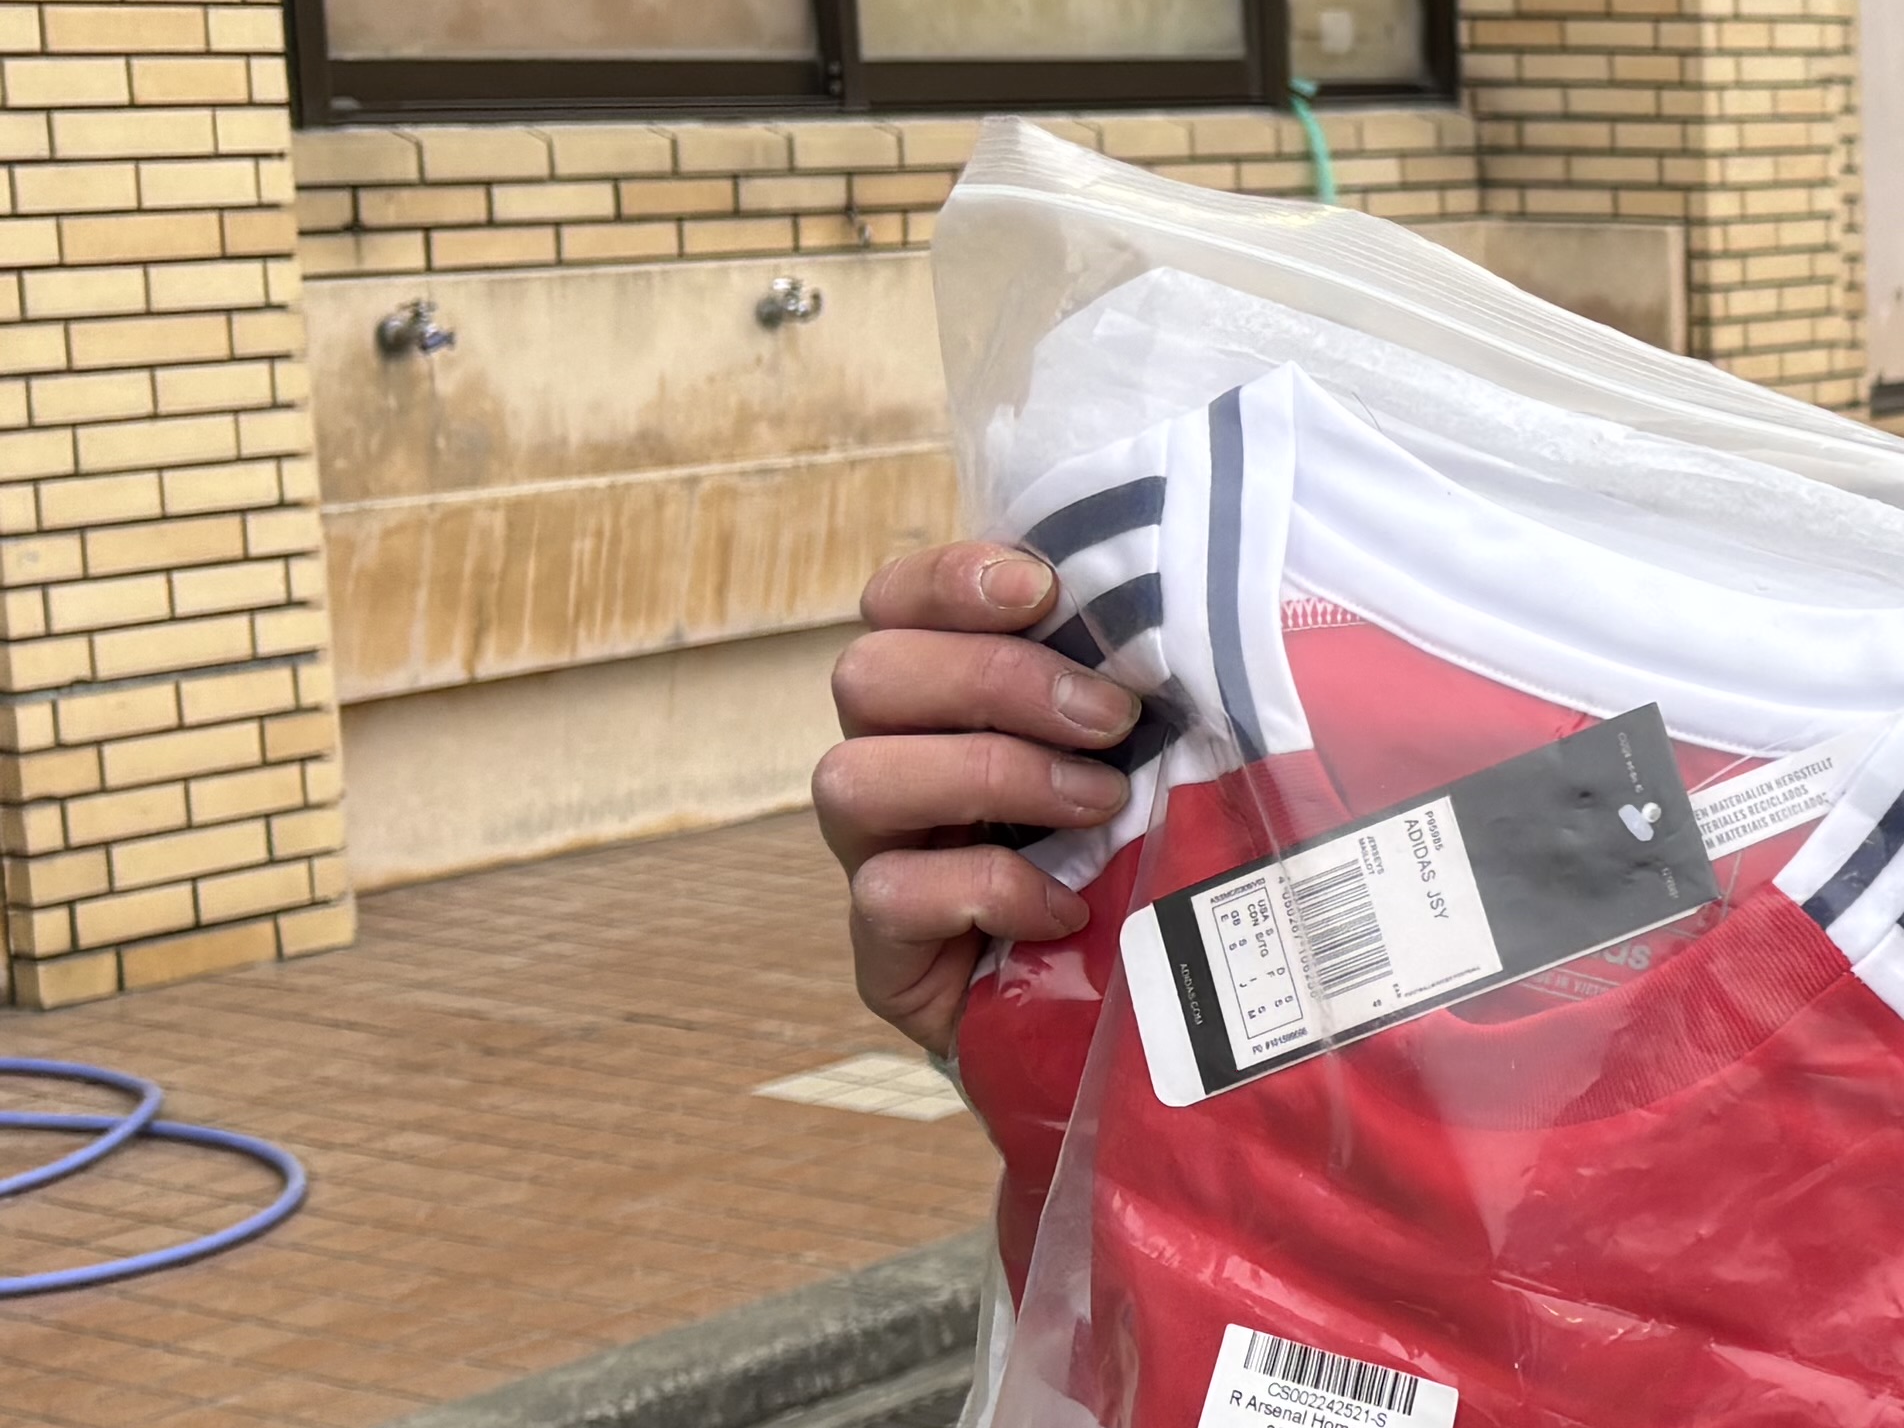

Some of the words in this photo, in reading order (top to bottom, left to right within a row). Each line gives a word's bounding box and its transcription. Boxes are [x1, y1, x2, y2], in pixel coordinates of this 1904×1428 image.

[1700, 809, 1747, 835] TERIALES
[1404, 818, 1436, 883] ADIDAS
[1427, 890, 1450, 919] JSY
[1247, 903, 1260, 927] CDN
[1257, 898, 1270, 922] USA
[1229, 1390, 1243, 1407] R
[1246, 1395, 1306, 1426] Arsenal
[1267, 1382, 1388, 1428] CS002242521-S
